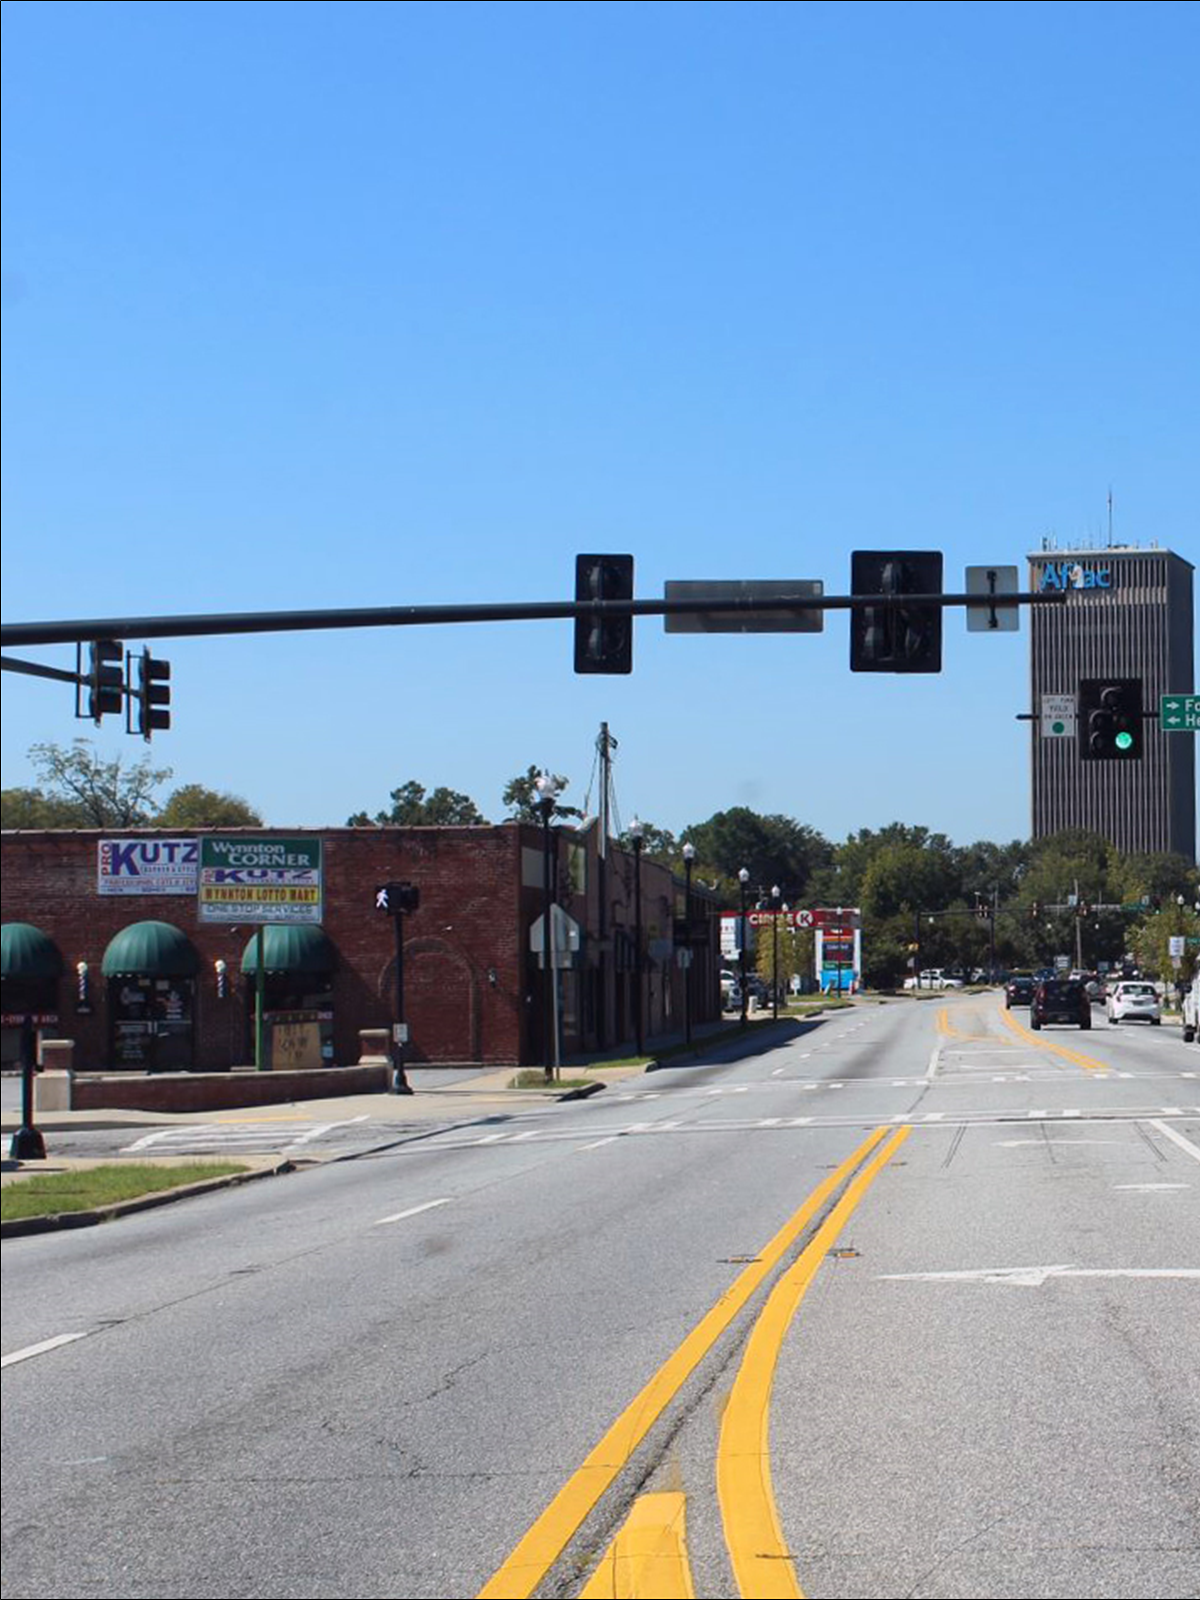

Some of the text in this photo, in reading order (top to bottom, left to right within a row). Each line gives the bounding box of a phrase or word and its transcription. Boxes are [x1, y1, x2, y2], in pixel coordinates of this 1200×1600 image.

[212, 842, 285, 855] Wynnton
[101, 843, 112, 876] PRO
[111, 843, 198, 876] KUTZ
[228, 853, 311, 866] CORNER
[214, 869, 313, 883] KUTZ
[205, 888, 254, 900] WYNNTON
[257, 888, 287, 900] LOTTO
[288, 888, 317, 900] MART
